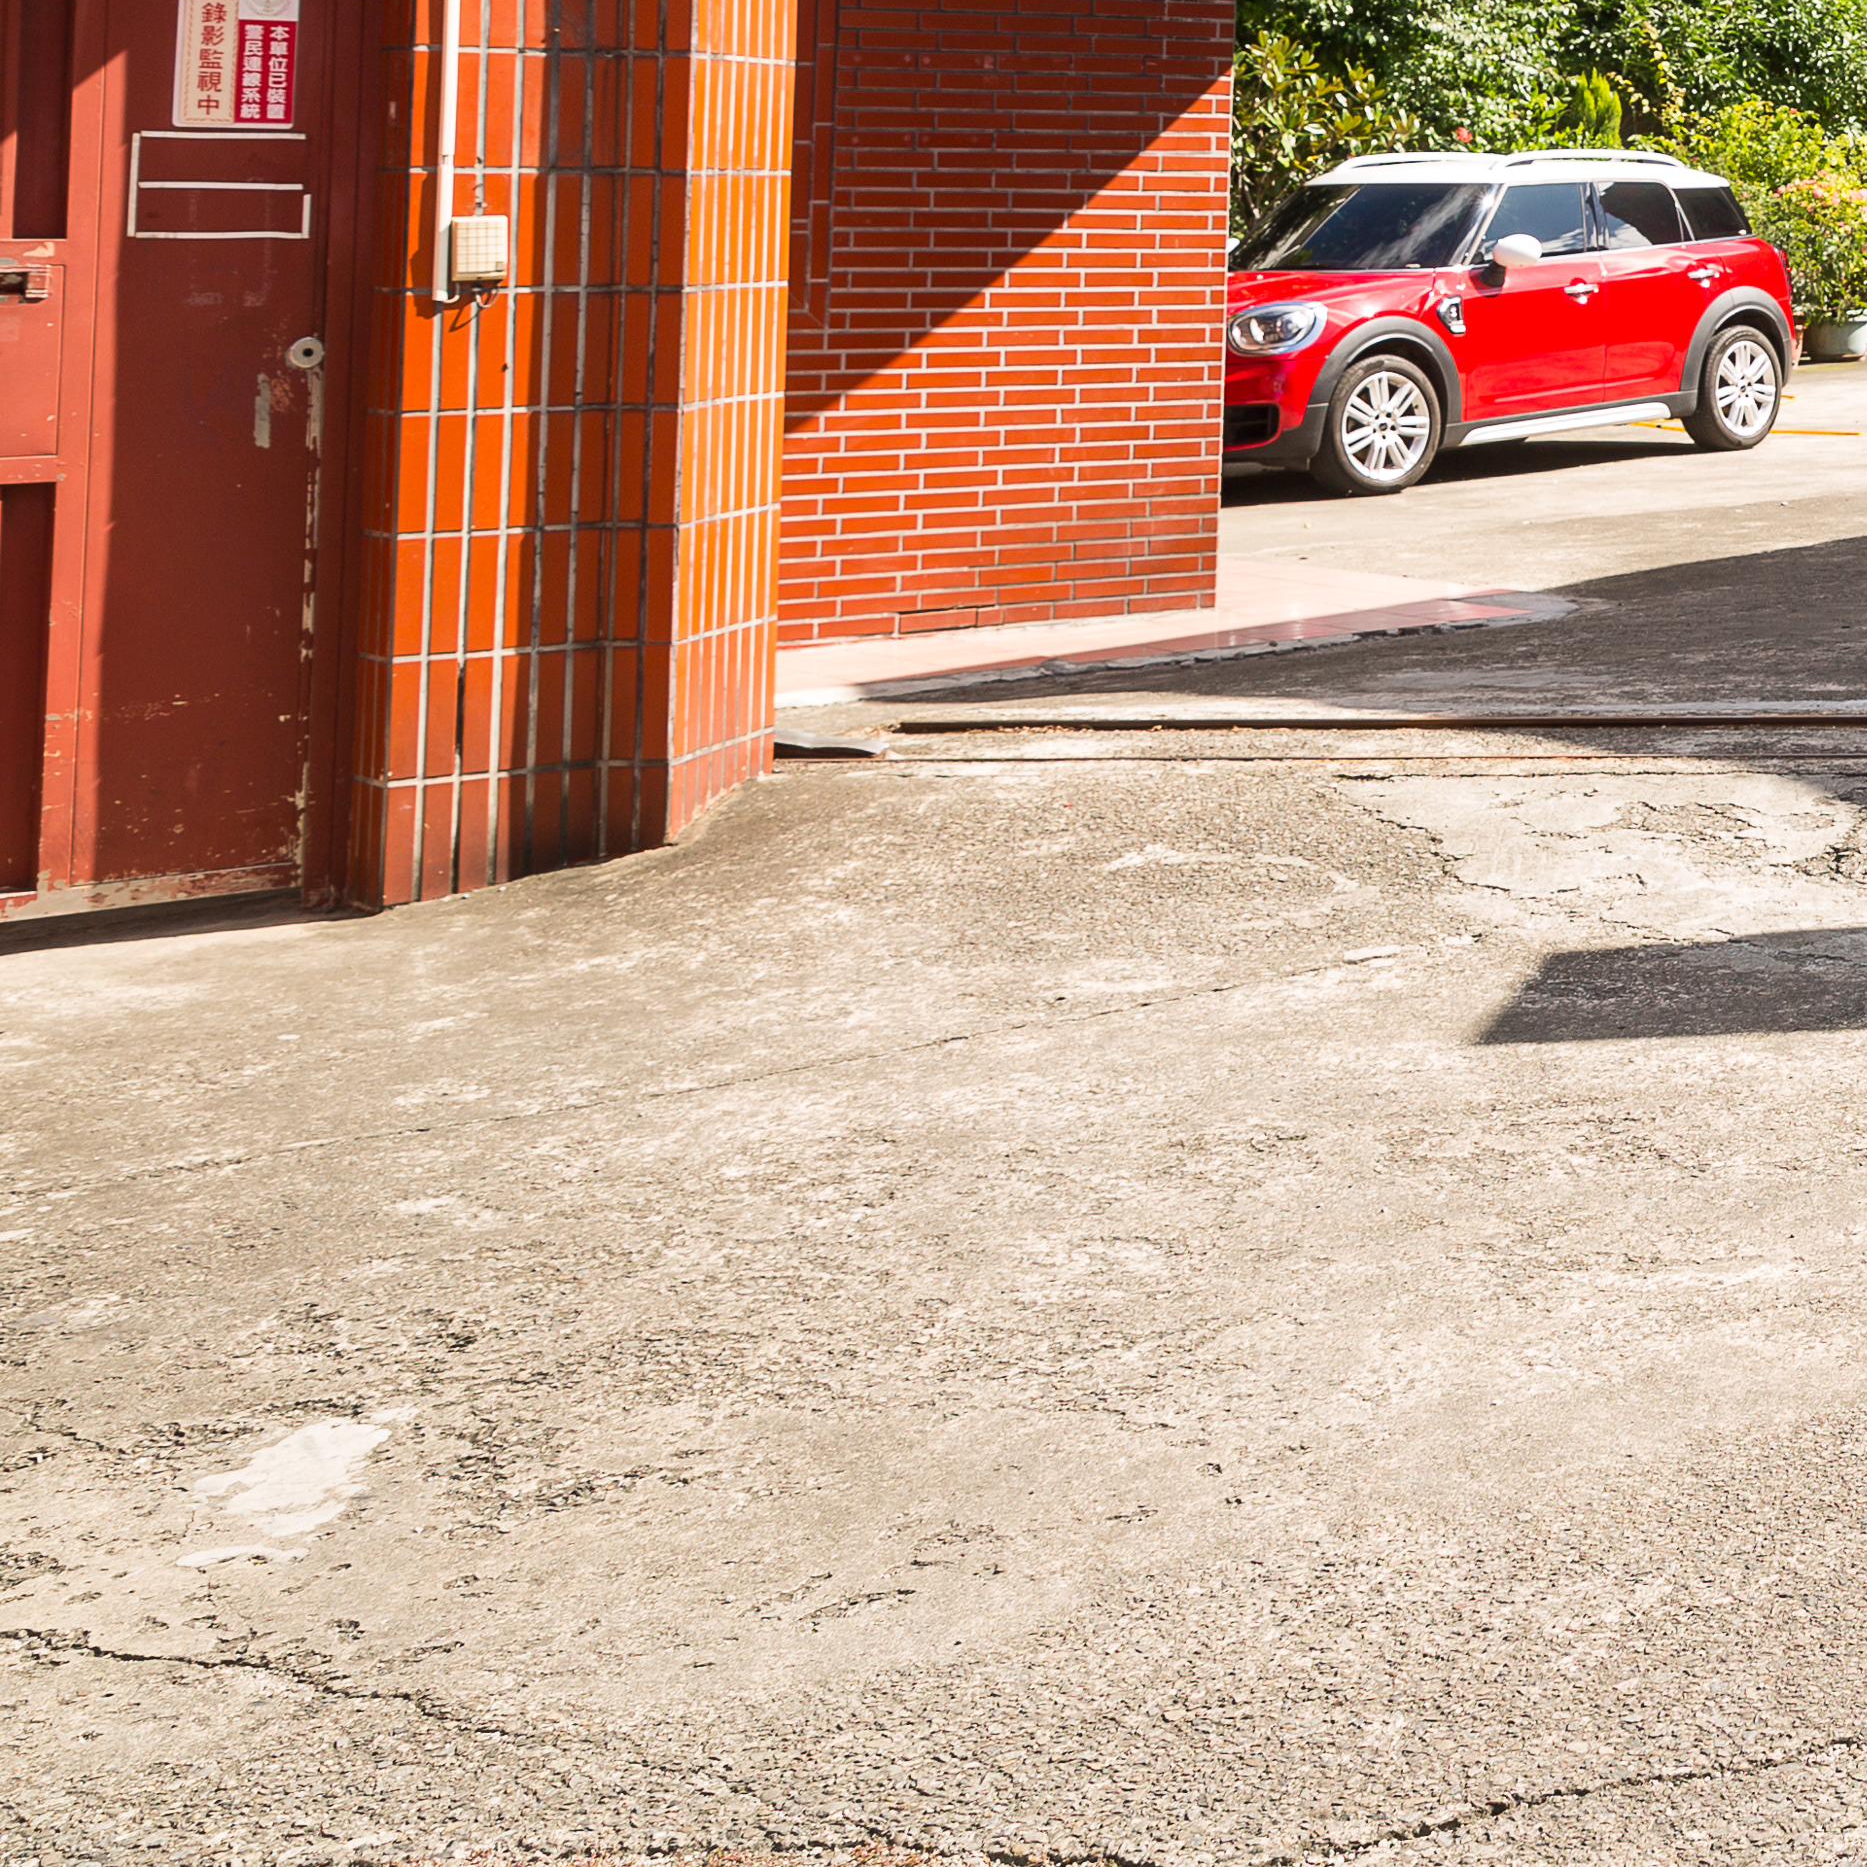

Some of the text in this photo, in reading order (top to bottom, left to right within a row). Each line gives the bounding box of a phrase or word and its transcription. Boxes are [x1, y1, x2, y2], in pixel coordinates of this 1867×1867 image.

[197, 2, 227, 115] 錄影監視中
